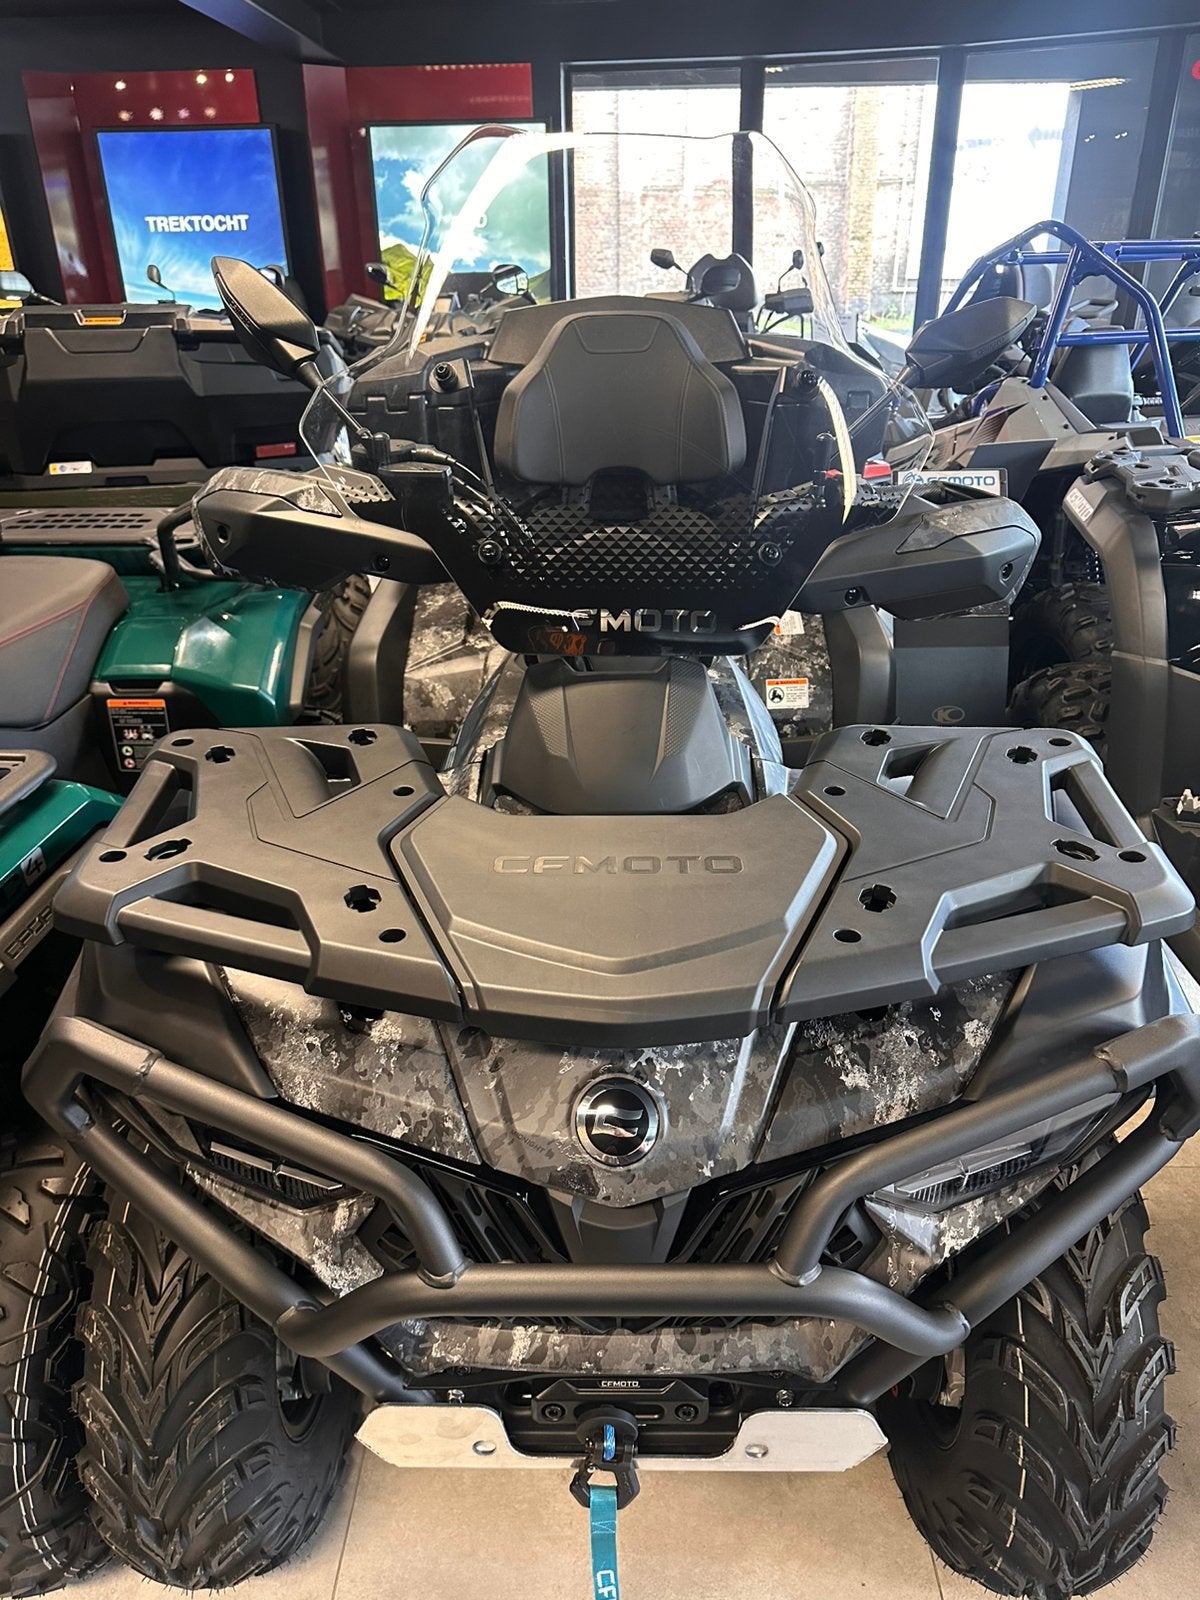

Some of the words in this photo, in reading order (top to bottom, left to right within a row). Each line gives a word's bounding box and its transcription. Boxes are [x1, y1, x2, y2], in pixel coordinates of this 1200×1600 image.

[144, 214, 249, 232] TREKTOCHT
[492, 855, 745, 875] CFMOTO
[601, 1380, 639, 1388] CFMOTO
